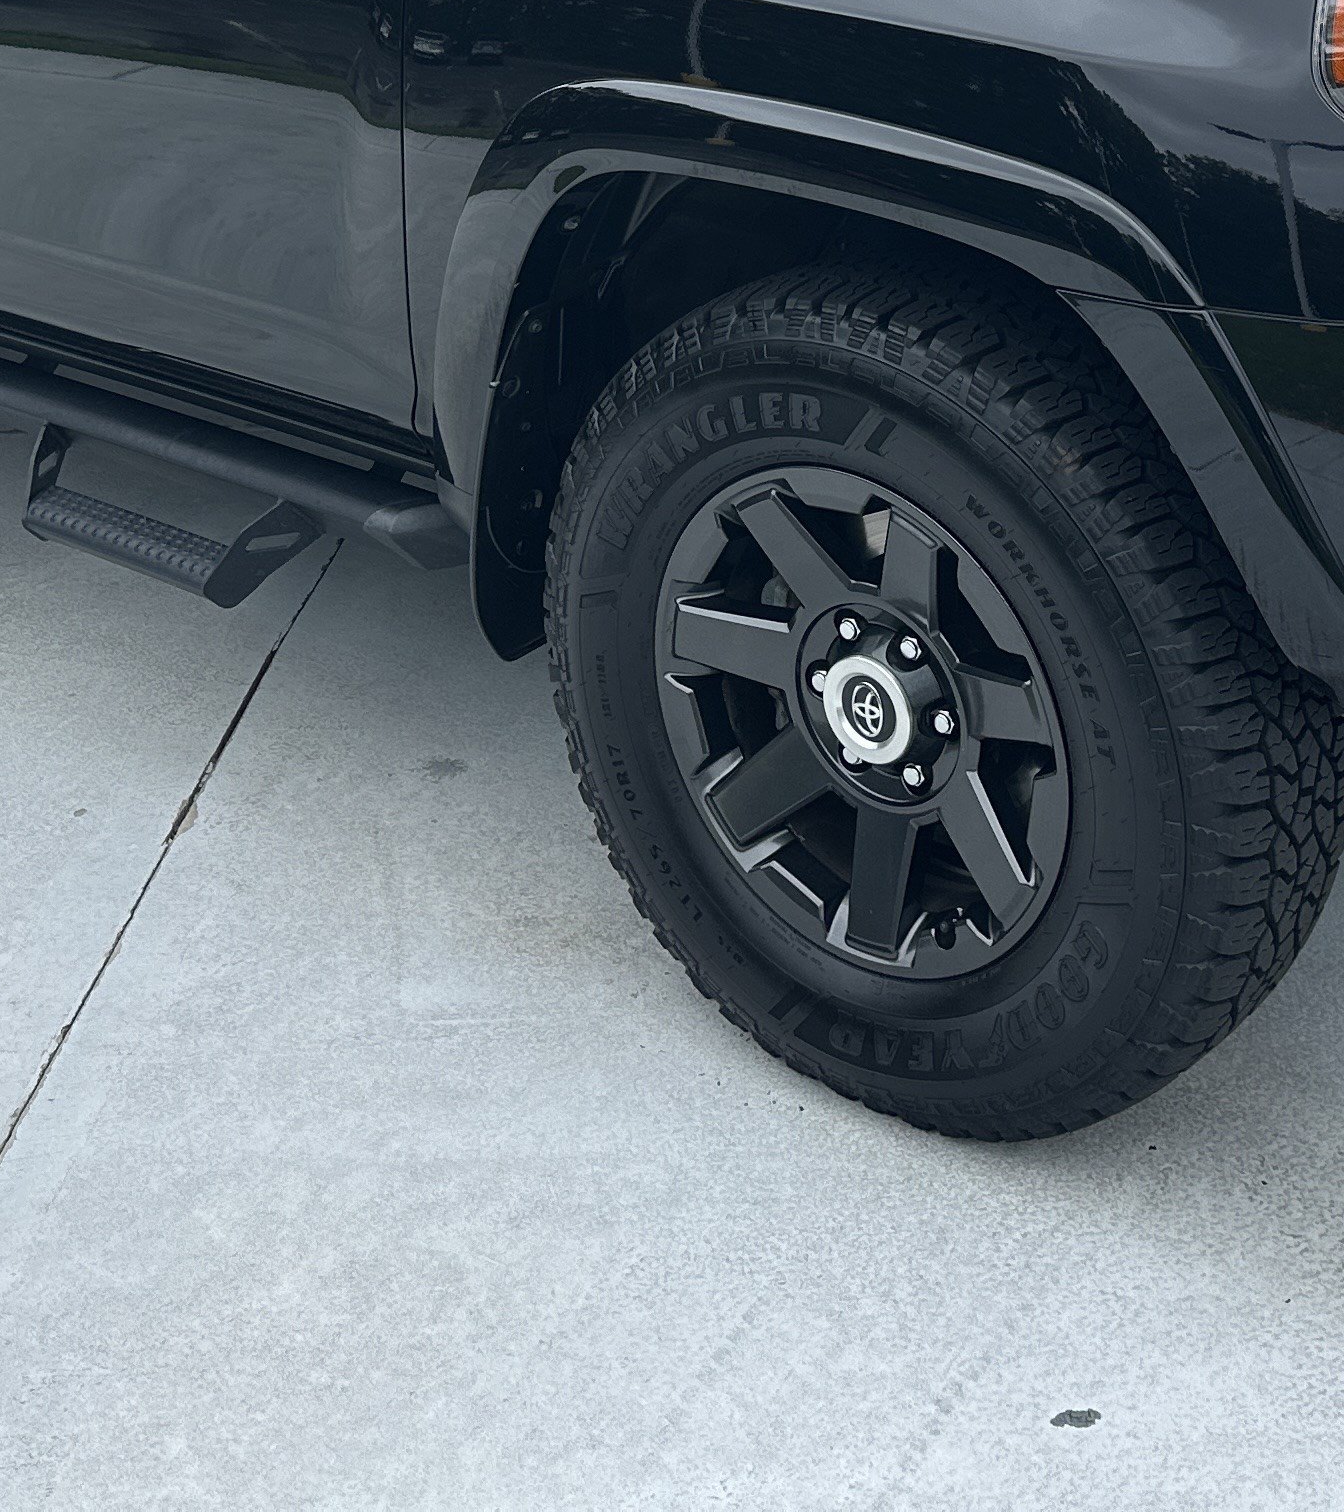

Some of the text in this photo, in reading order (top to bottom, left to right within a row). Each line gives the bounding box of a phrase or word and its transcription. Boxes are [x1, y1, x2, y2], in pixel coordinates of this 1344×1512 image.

[597, 392, 822, 550] WRANGLER
[965, 493, 1117, 771] WORKHORSE AT
